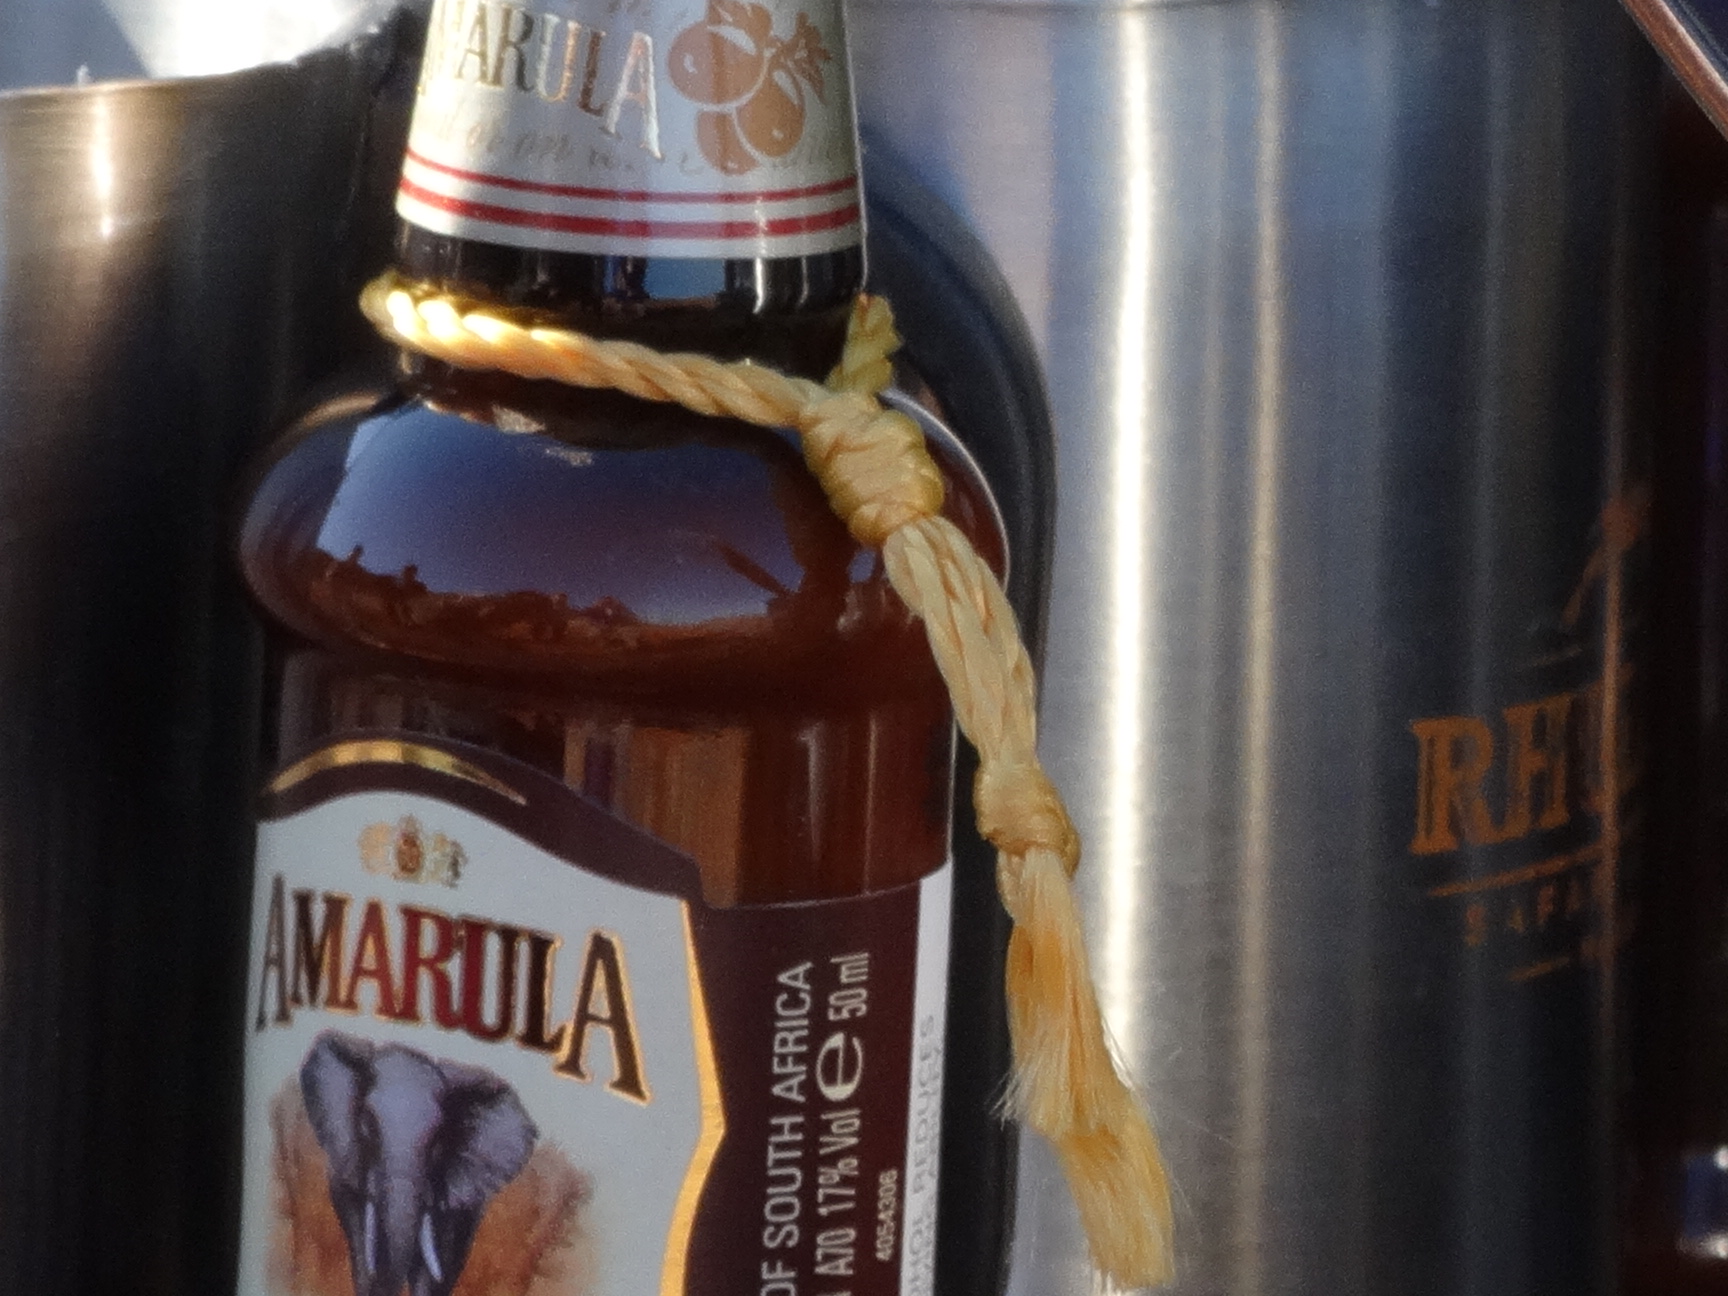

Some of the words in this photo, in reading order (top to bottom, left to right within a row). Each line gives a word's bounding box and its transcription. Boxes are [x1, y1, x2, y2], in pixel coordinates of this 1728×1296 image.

[254, 874, 652, 1107] AMARULA
[831, 952, 871, 982] ml
[772, 962, 813, 1102] AFRICA
[827, 987, 869, 1023] 50
[821, 1109, 860, 1154] Vol
[763, 1116, 805, 1247] SOUTH
[818, 1158, 858, 1213] 17%
